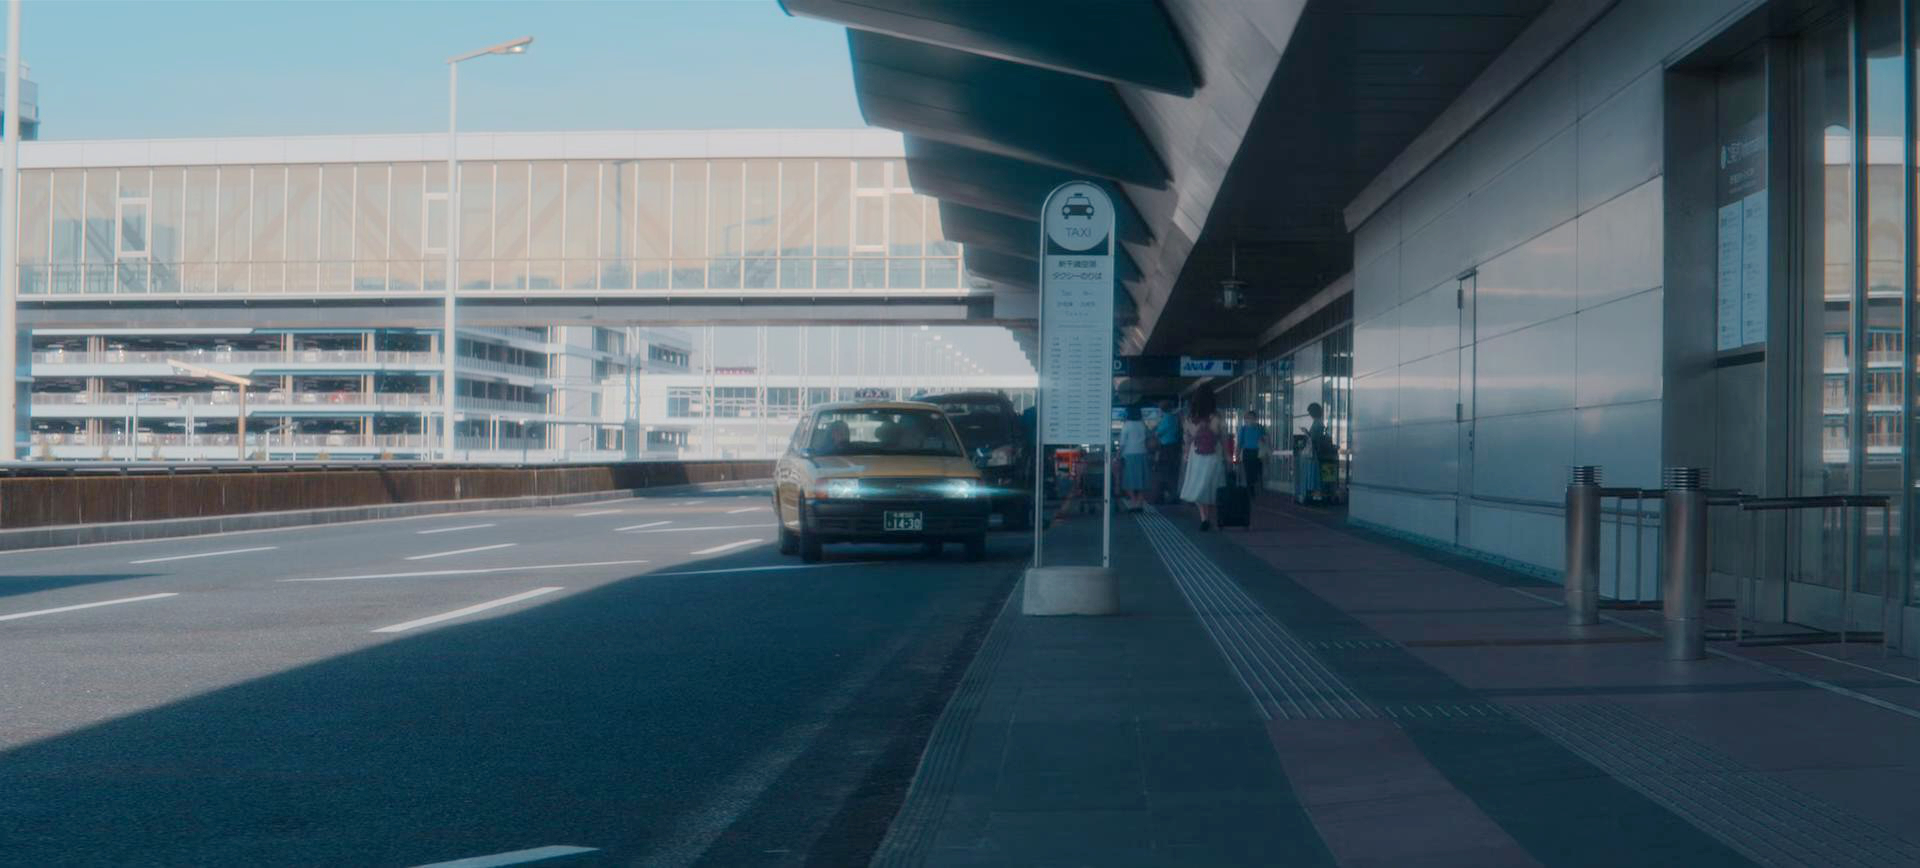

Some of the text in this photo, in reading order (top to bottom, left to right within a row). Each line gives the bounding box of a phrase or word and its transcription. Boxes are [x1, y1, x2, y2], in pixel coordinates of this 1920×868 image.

[1066, 227, 1091, 237] TAXI
[1052, 272, 1102, 280] タクシーのりば
[1183, 362, 1205, 371] ANA
